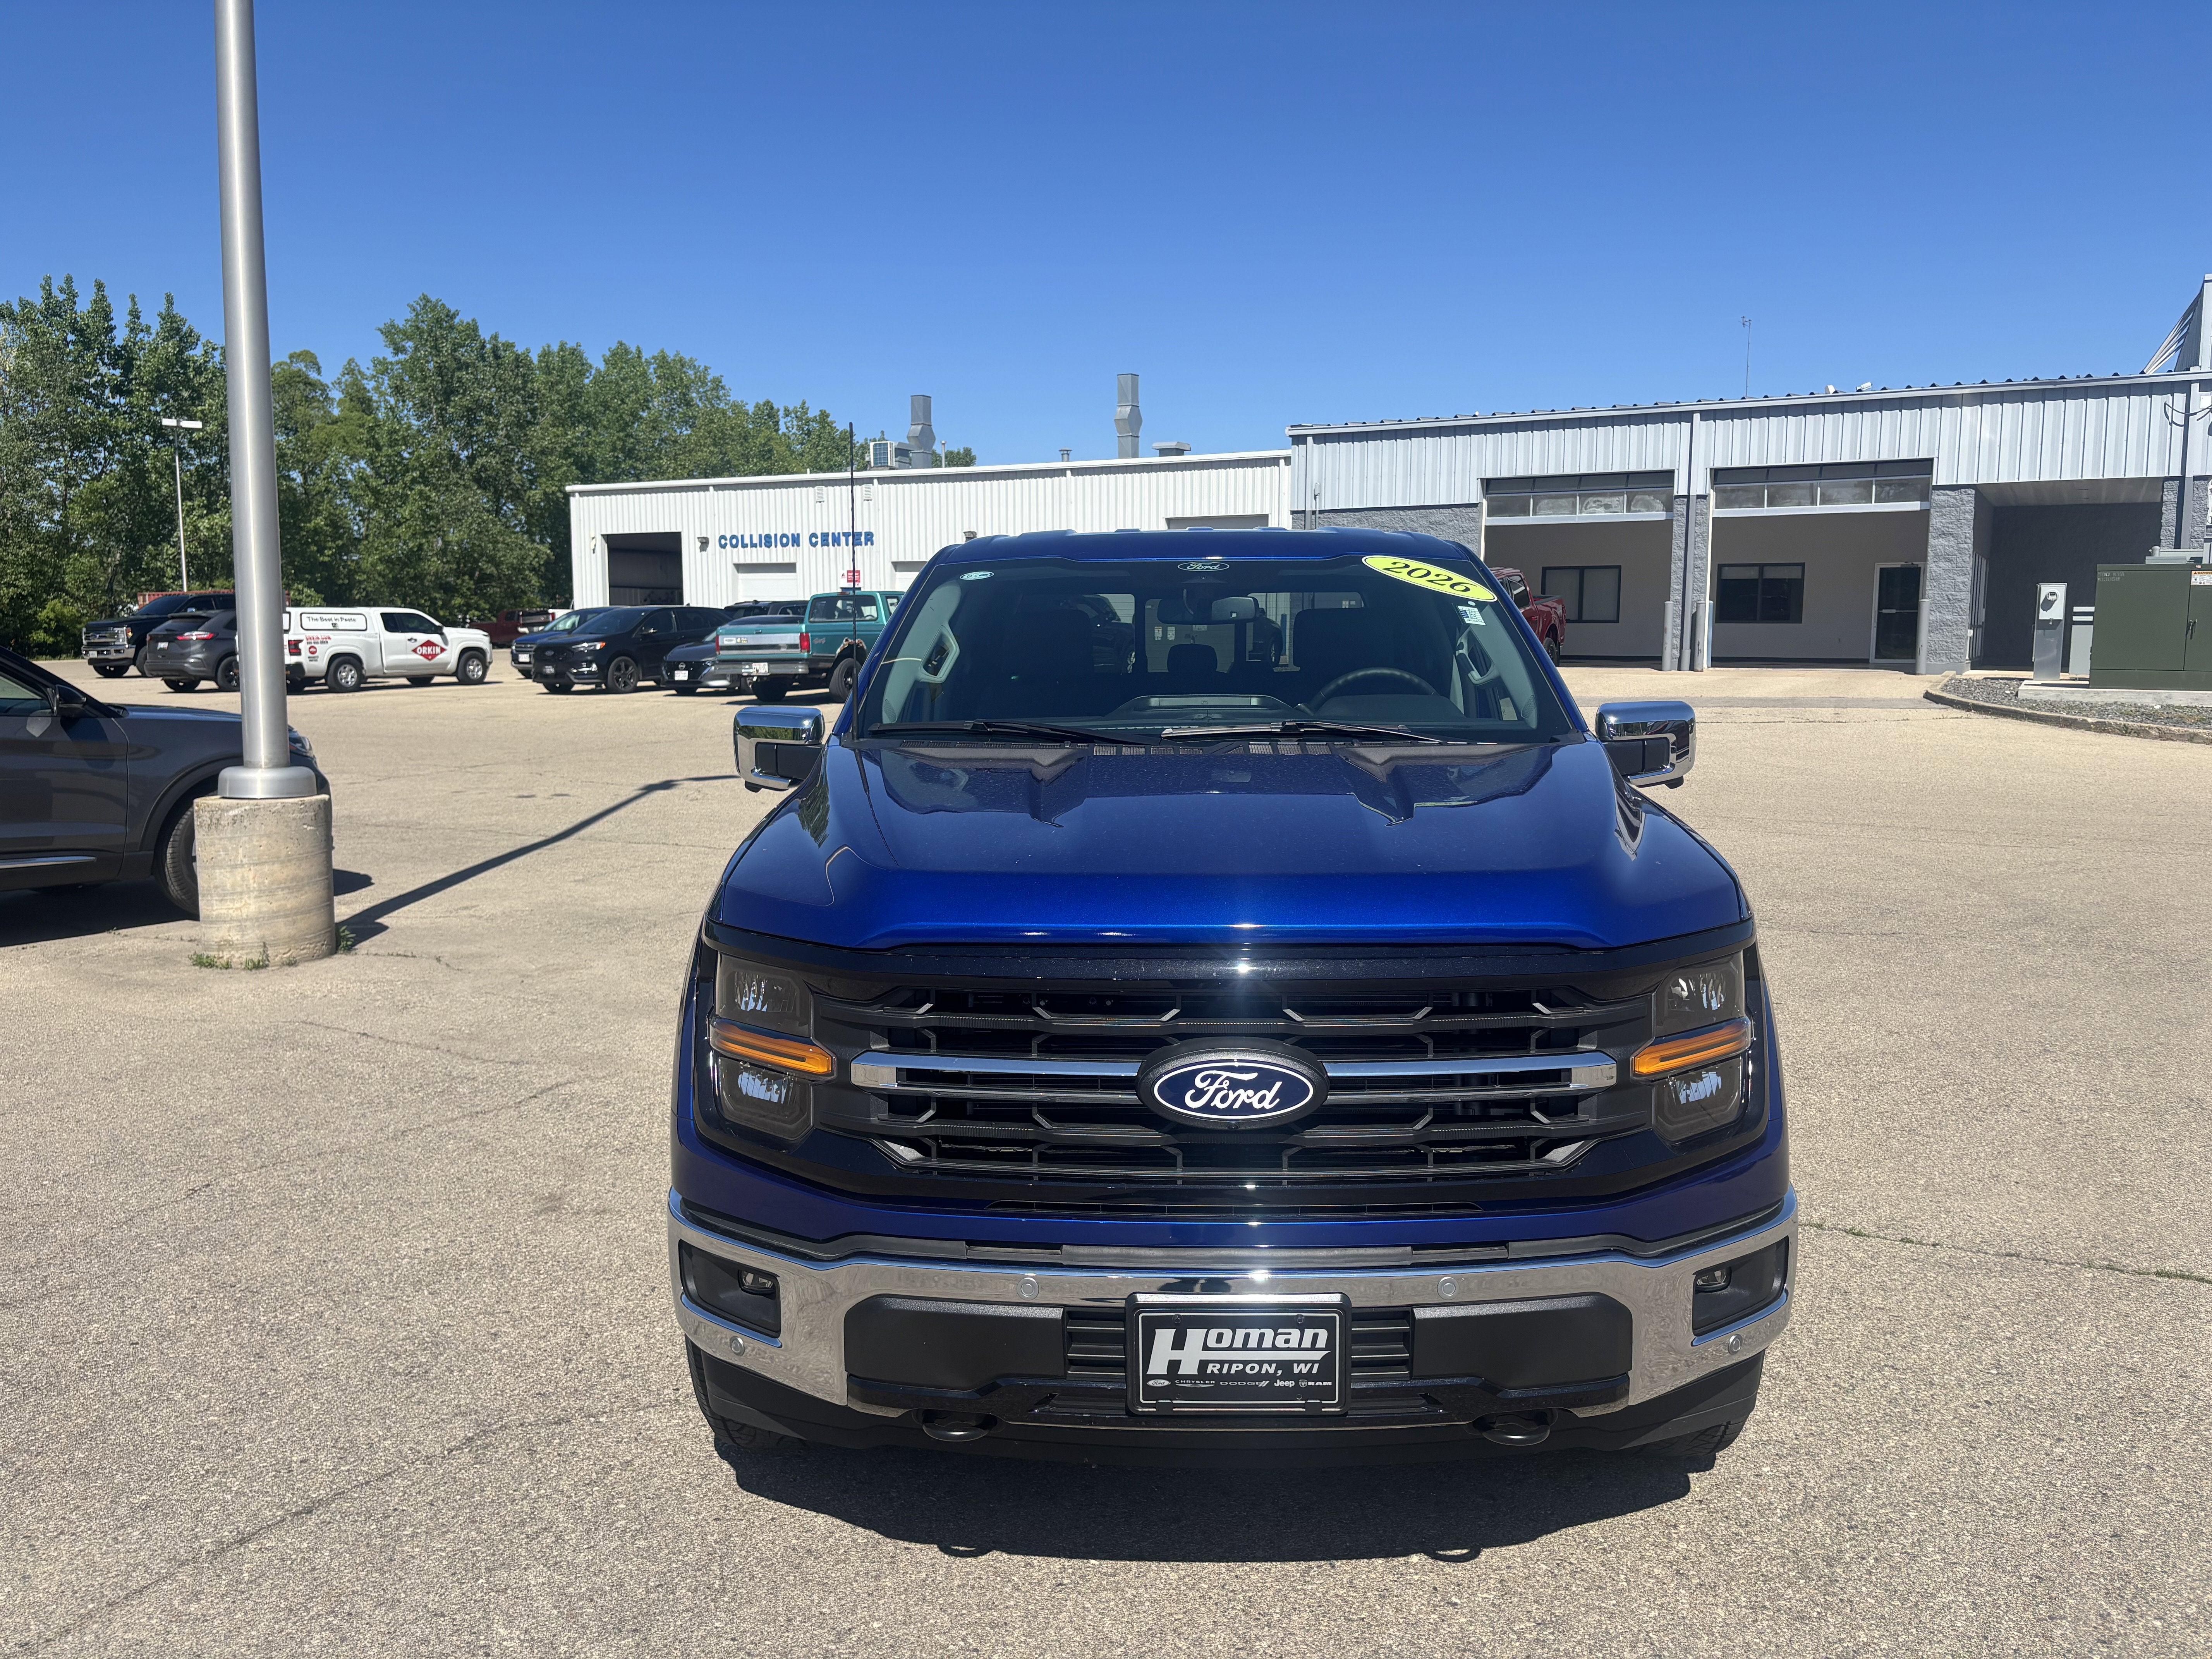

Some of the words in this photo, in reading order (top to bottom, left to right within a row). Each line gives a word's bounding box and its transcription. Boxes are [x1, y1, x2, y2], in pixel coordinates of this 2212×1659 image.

[718, 533, 800, 549] COLLISION
[809, 531, 874, 547] CENTER
[1382, 562, 1477, 592] 2026
[416, 646, 441, 654] ORKIN
[1185, 1070, 1283, 1109] Ford
[1146, 1328, 1331, 1375] Homan
[1206, 1363, 1283, 1376] RIPON,
[1293, 1363, 1319, 1374] WI
[1274, 1379, 1295, 1388] Jeep
